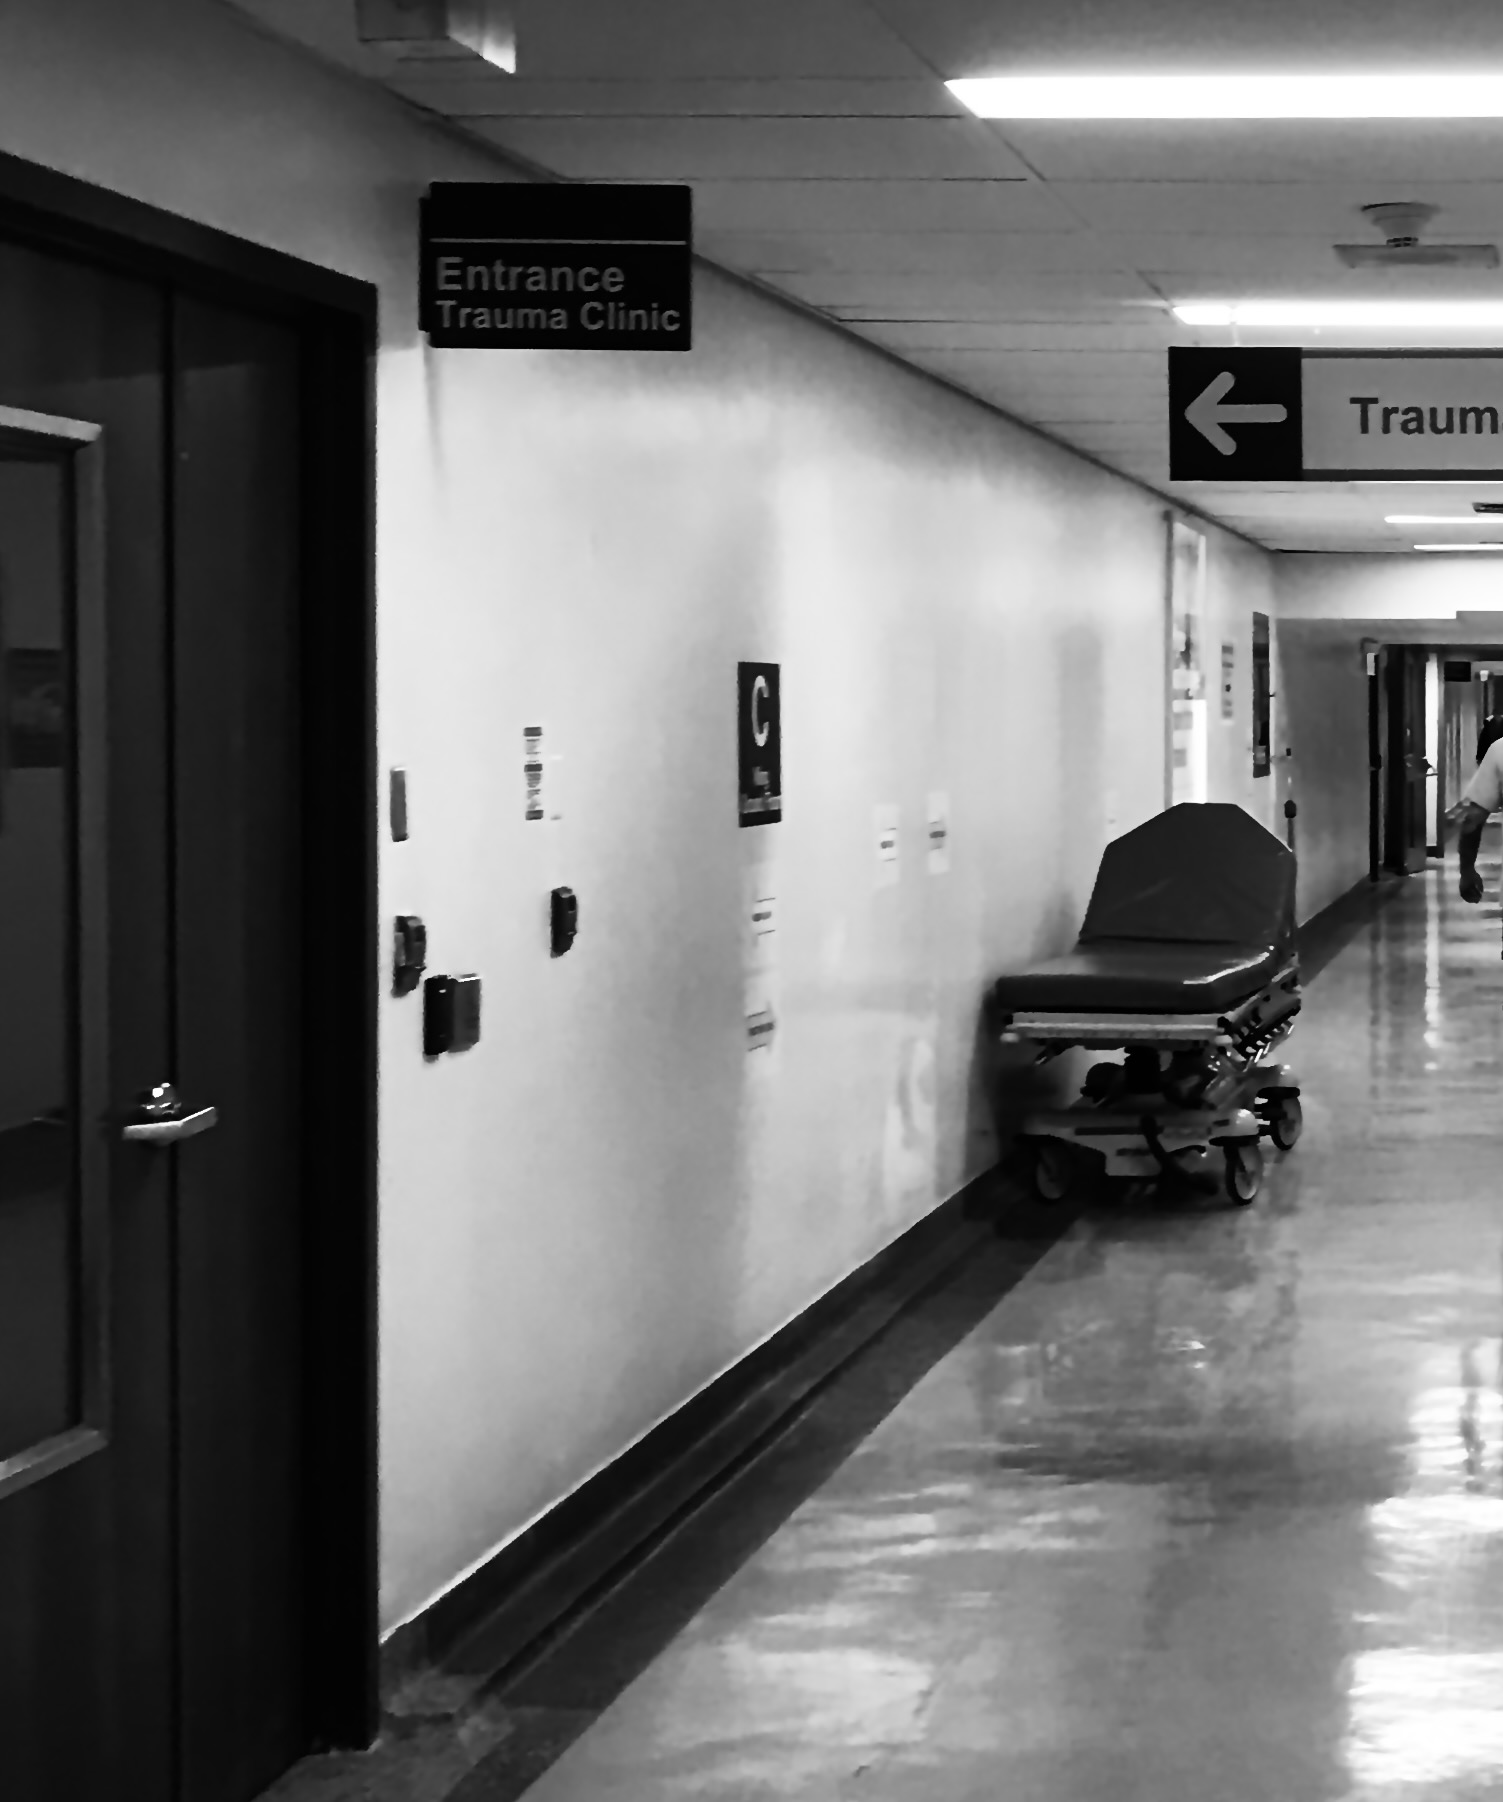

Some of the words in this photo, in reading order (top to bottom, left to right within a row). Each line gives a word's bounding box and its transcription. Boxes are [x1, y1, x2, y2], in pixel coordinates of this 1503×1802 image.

[435, 256, 625, 293] Entrance
[435, 300, 568, 330] Trauma
[579, 301, 681, 331] Clinic
[751, 675, 770, 747] C
